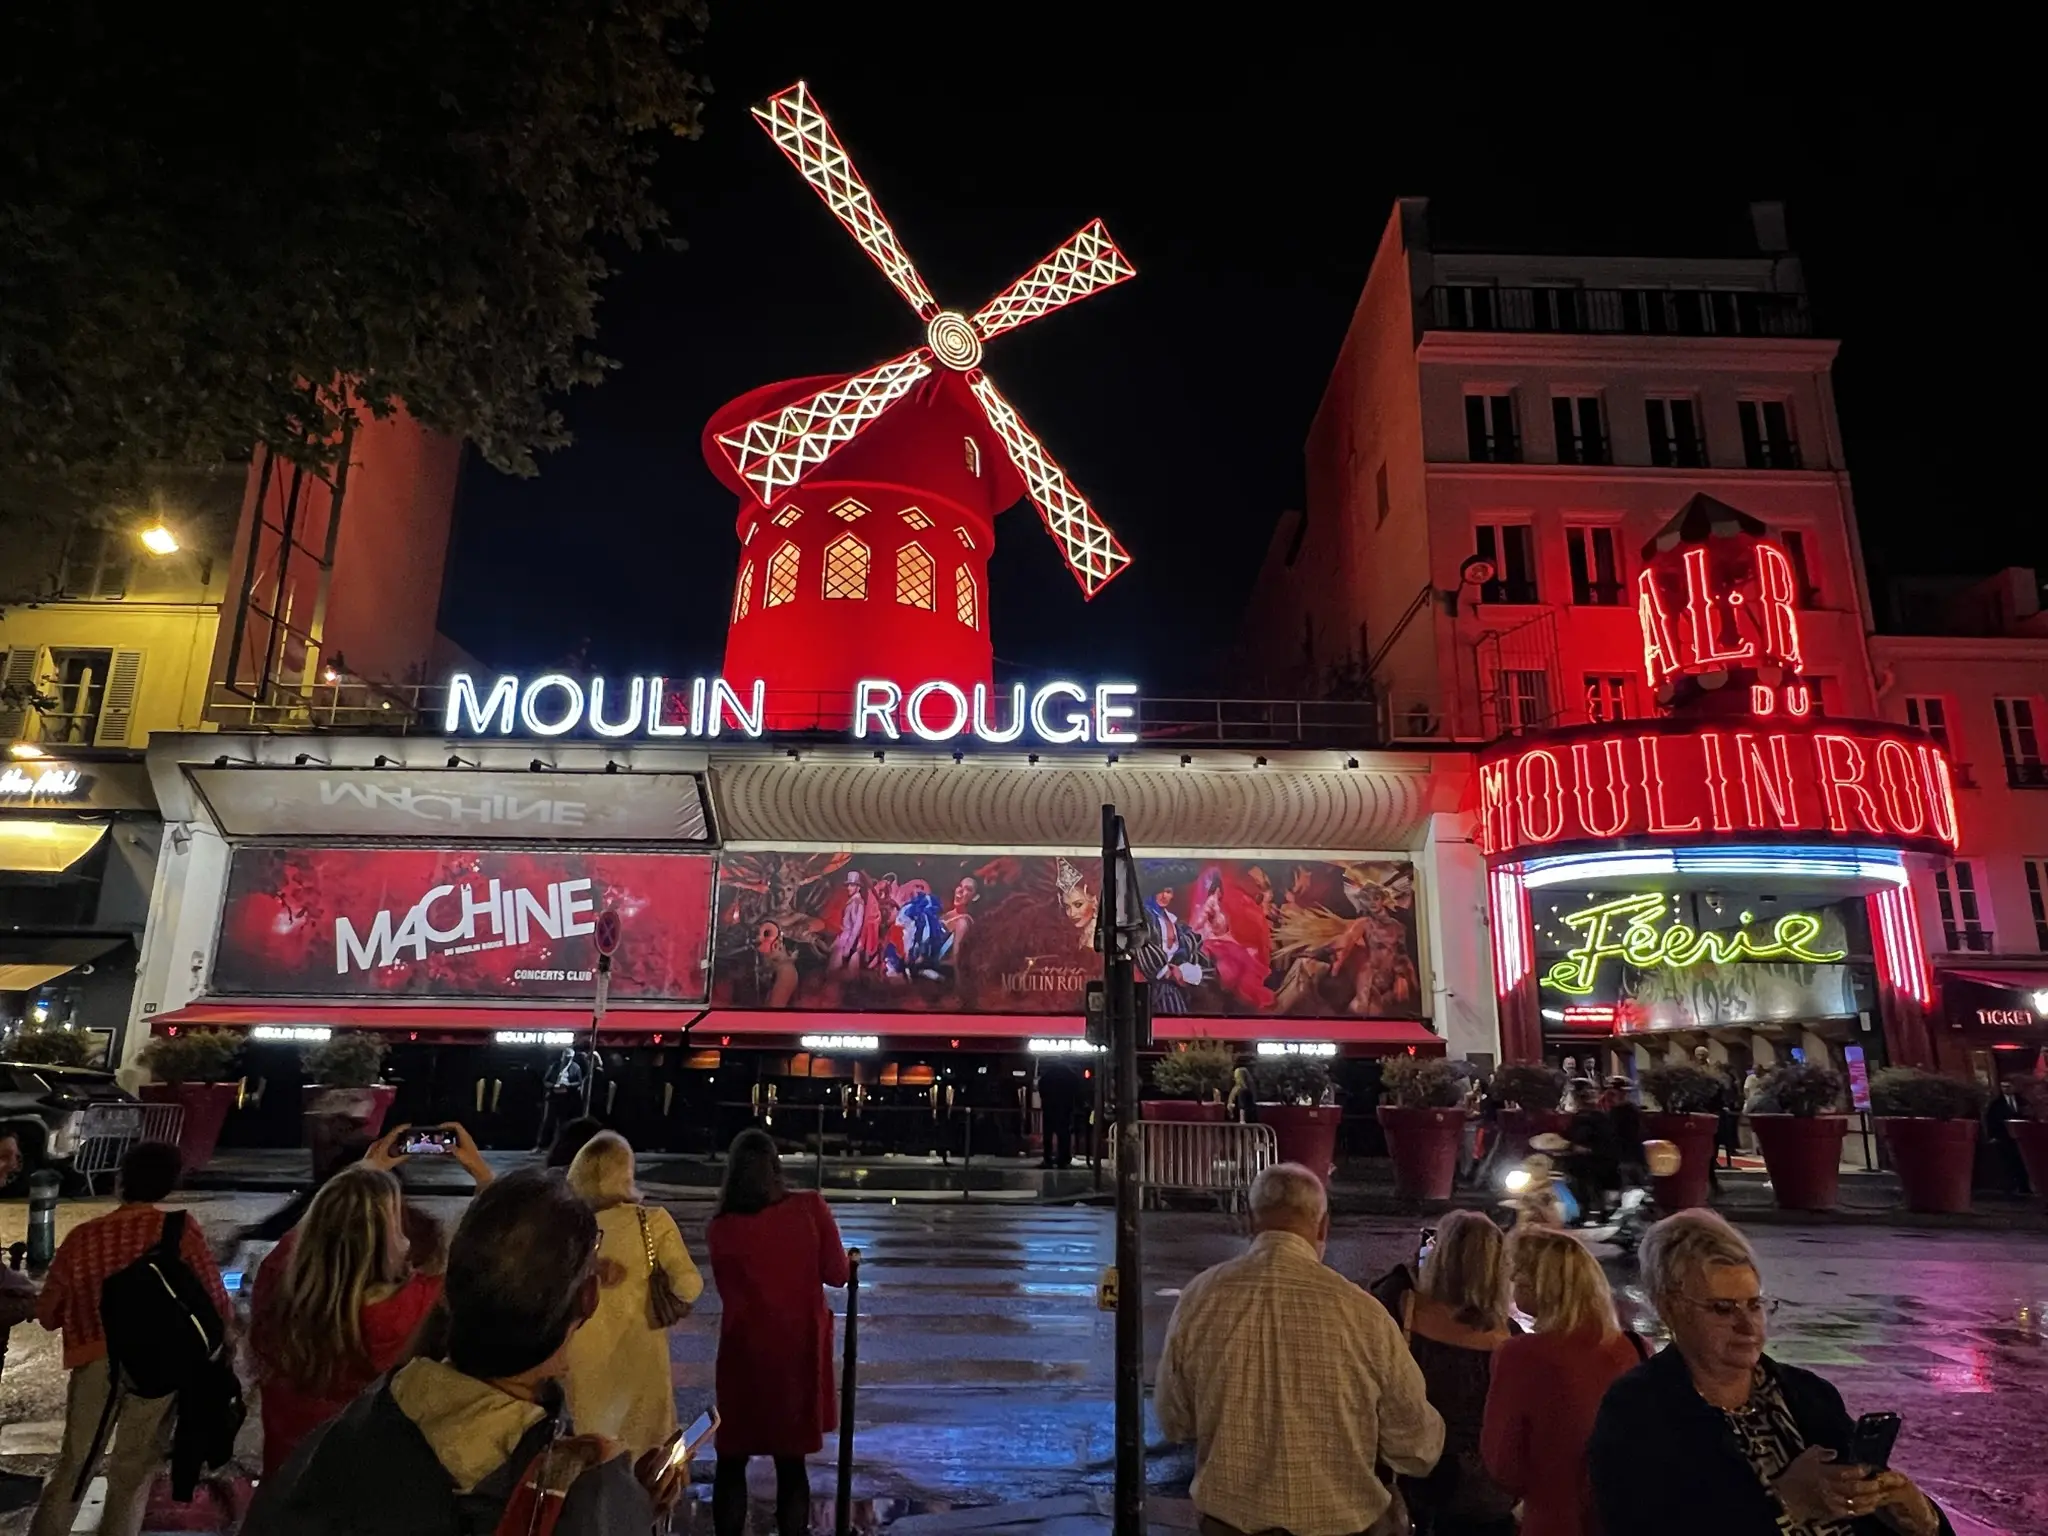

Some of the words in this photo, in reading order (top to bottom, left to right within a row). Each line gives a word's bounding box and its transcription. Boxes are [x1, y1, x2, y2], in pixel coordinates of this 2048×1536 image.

[445, 674, 765, 737] MOULIN
[852, 680, 1140, 744] ROUGE
[1752, 684, 1809, 716] DU
[1479, 733, 1801, 854] MOULIN
[335, 878, 595, 975] MACHINE
[514, 969, 565, 981] CONCERTS
[566, 970, 592, 981] CLUB
[1001, 972, 1054, 995] MOULIN
[1057, 974, 1092, 991] ROU
[1976, 1009, 2032, 1026] TICKET
